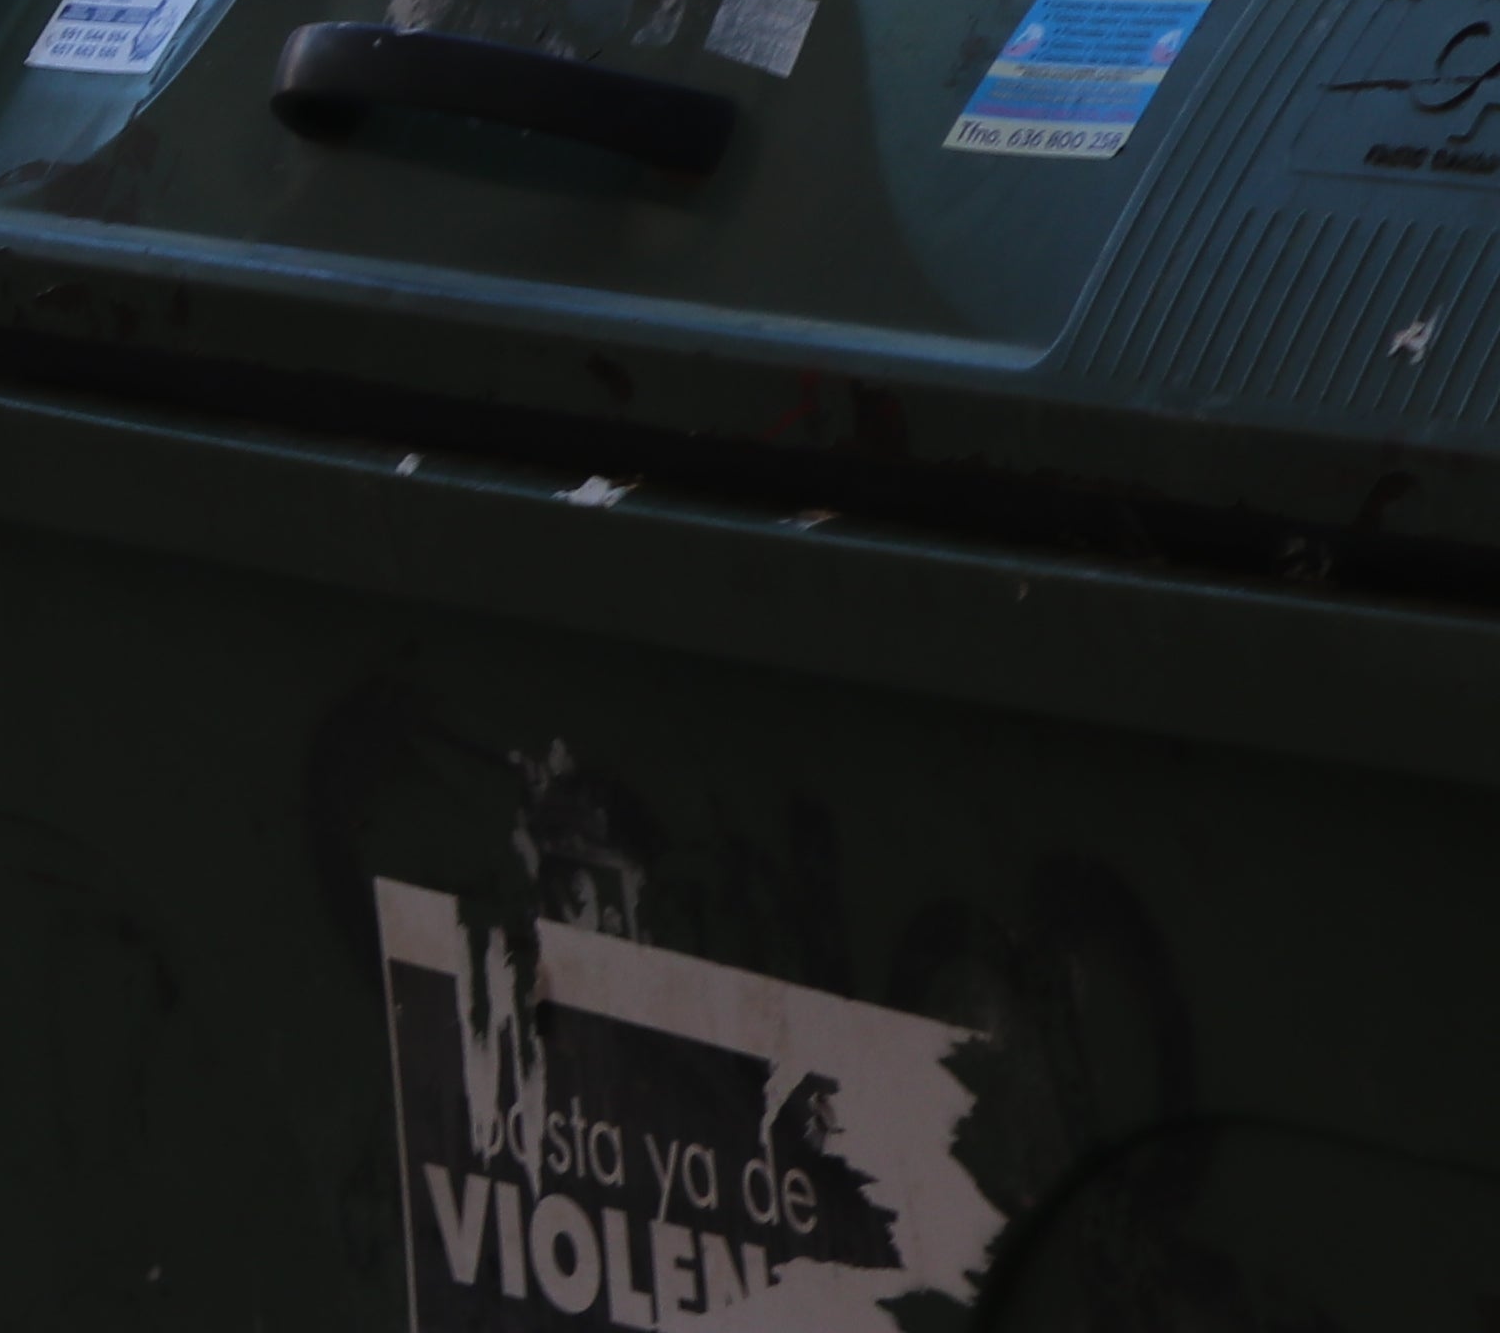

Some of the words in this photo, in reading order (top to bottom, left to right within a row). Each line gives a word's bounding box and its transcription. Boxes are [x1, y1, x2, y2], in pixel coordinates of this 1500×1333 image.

[1006, 128, 1043, 148] 636
[644, 1131, 719, 1223] ya
[743, 1118, 819, 1235] de
